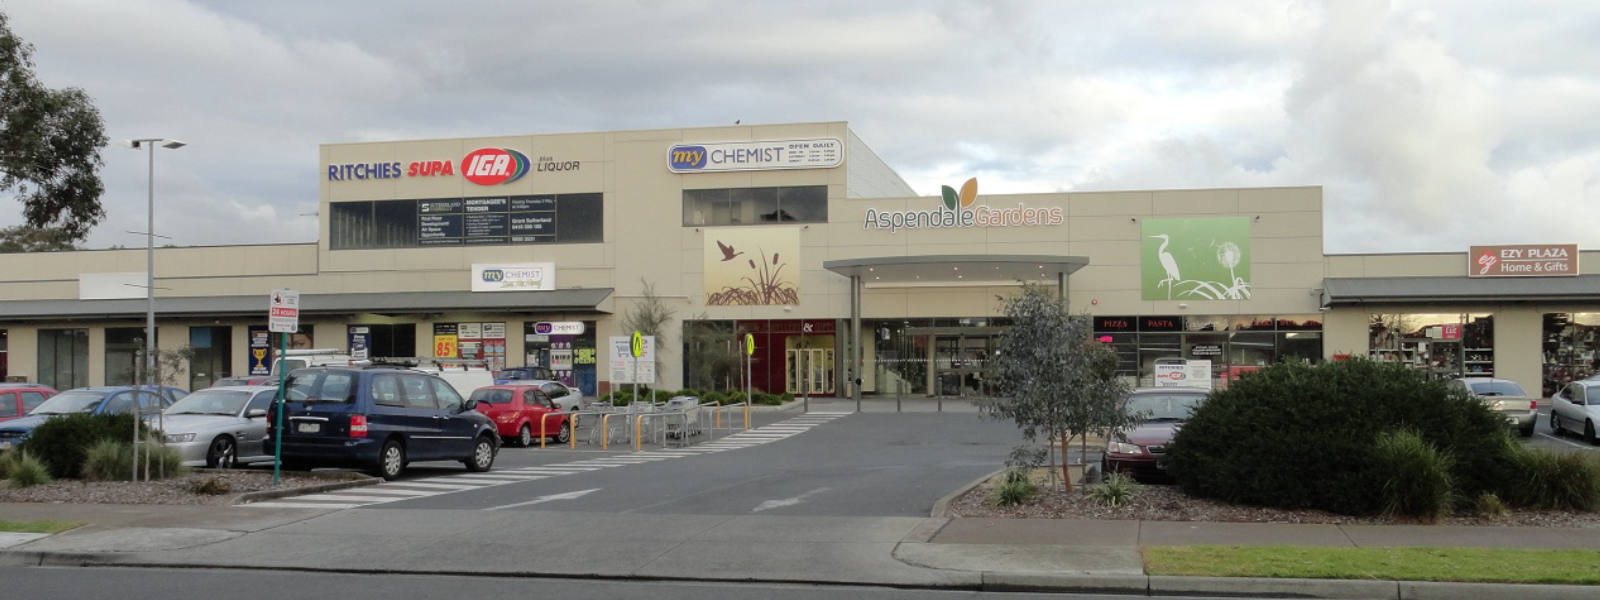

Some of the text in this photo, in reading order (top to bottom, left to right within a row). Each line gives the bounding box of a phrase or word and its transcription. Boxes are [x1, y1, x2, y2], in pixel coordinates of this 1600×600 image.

[673, 147, 785, 166] my CHEMIST
[328, 154, 510, 181] RITCHIES SUPA IGA
[537, 161, 580, 172] LIQUOR
[1501, 248, 1568, 258] EZY PLAZA
[1501, 262, 1568, 272] Home & Gifts
[505, 271, 540, 279] CHEMIST
[536, 324, 550, 332] my
